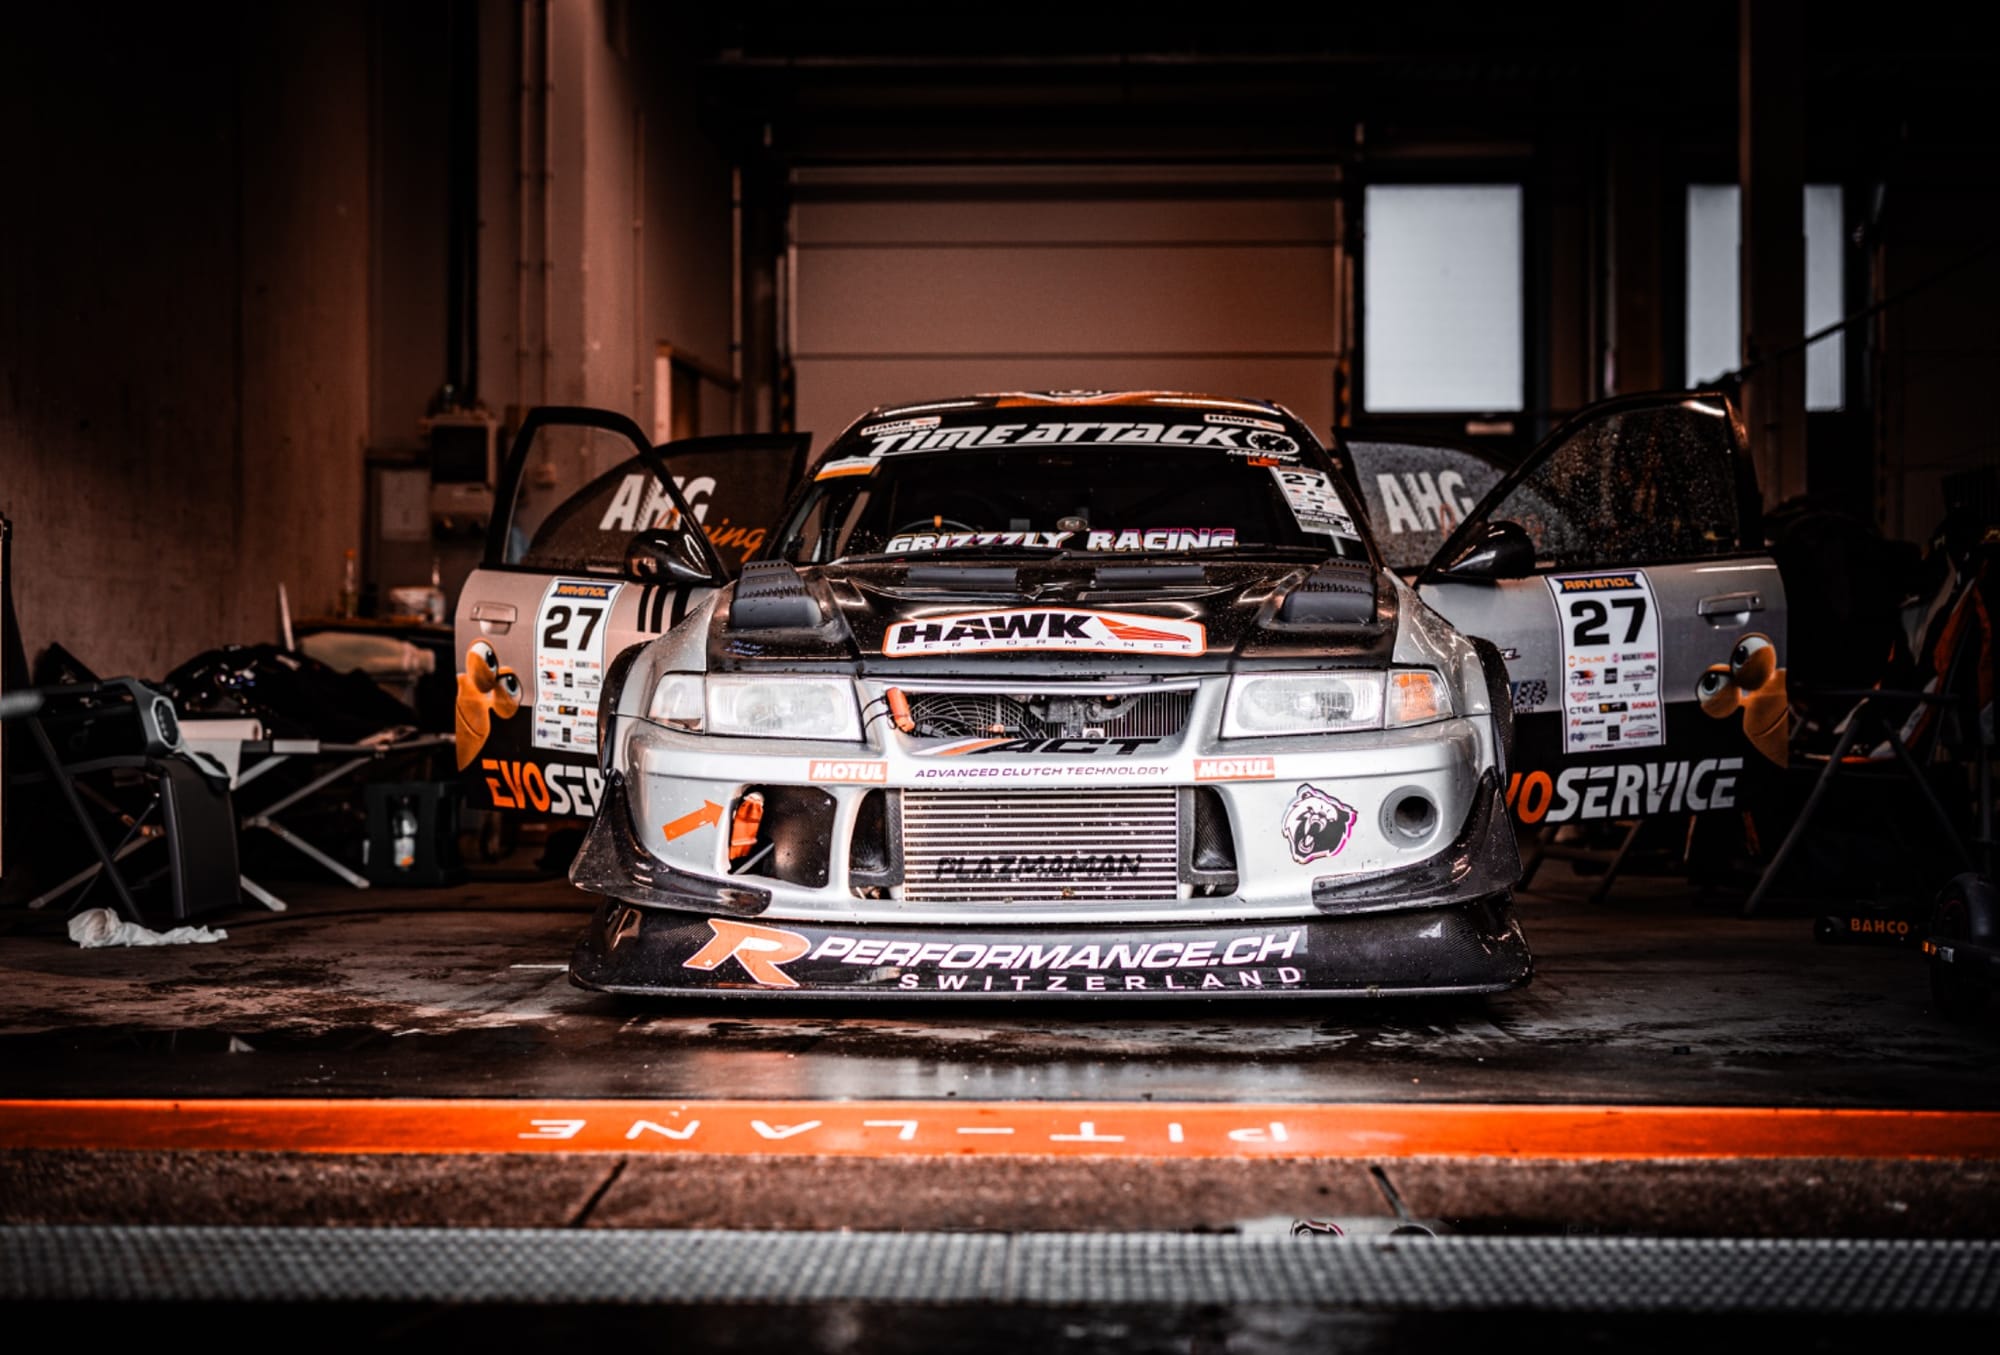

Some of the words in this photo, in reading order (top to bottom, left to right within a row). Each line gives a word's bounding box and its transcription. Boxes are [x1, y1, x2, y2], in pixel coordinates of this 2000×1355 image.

[1208, 414, 1256, 425] HAWK
[1282, 473, 1325, 488] 27
[1376, 470, 1477, 534] AHG
[1087, 528, 1235, 552] RACING
[1562, 577, 1635, 591] RAVENOL
[543, 605, 604, 651] 27
[897, 613, 1092, 643] HAWK
[1570, 597, 1647, 647] 27
[896, 638, 1192, 650] PERFORMANCE
[812, 762, 884, 779] MOTUL
[915, 768, 999, 778] ADVANCED
[1002, 768, 1063, 777] CLUTCH
[1067, 766, 1169, 776] TECHNOLOGY
[1197, 760, 1275, 777] MOTUL
[1851, 918, 1909, 935] BAHCO
[808, 931, 1302, 969] PERFORMANCE.CH
[899, 966, 1302, 991] SWITZERLAND
